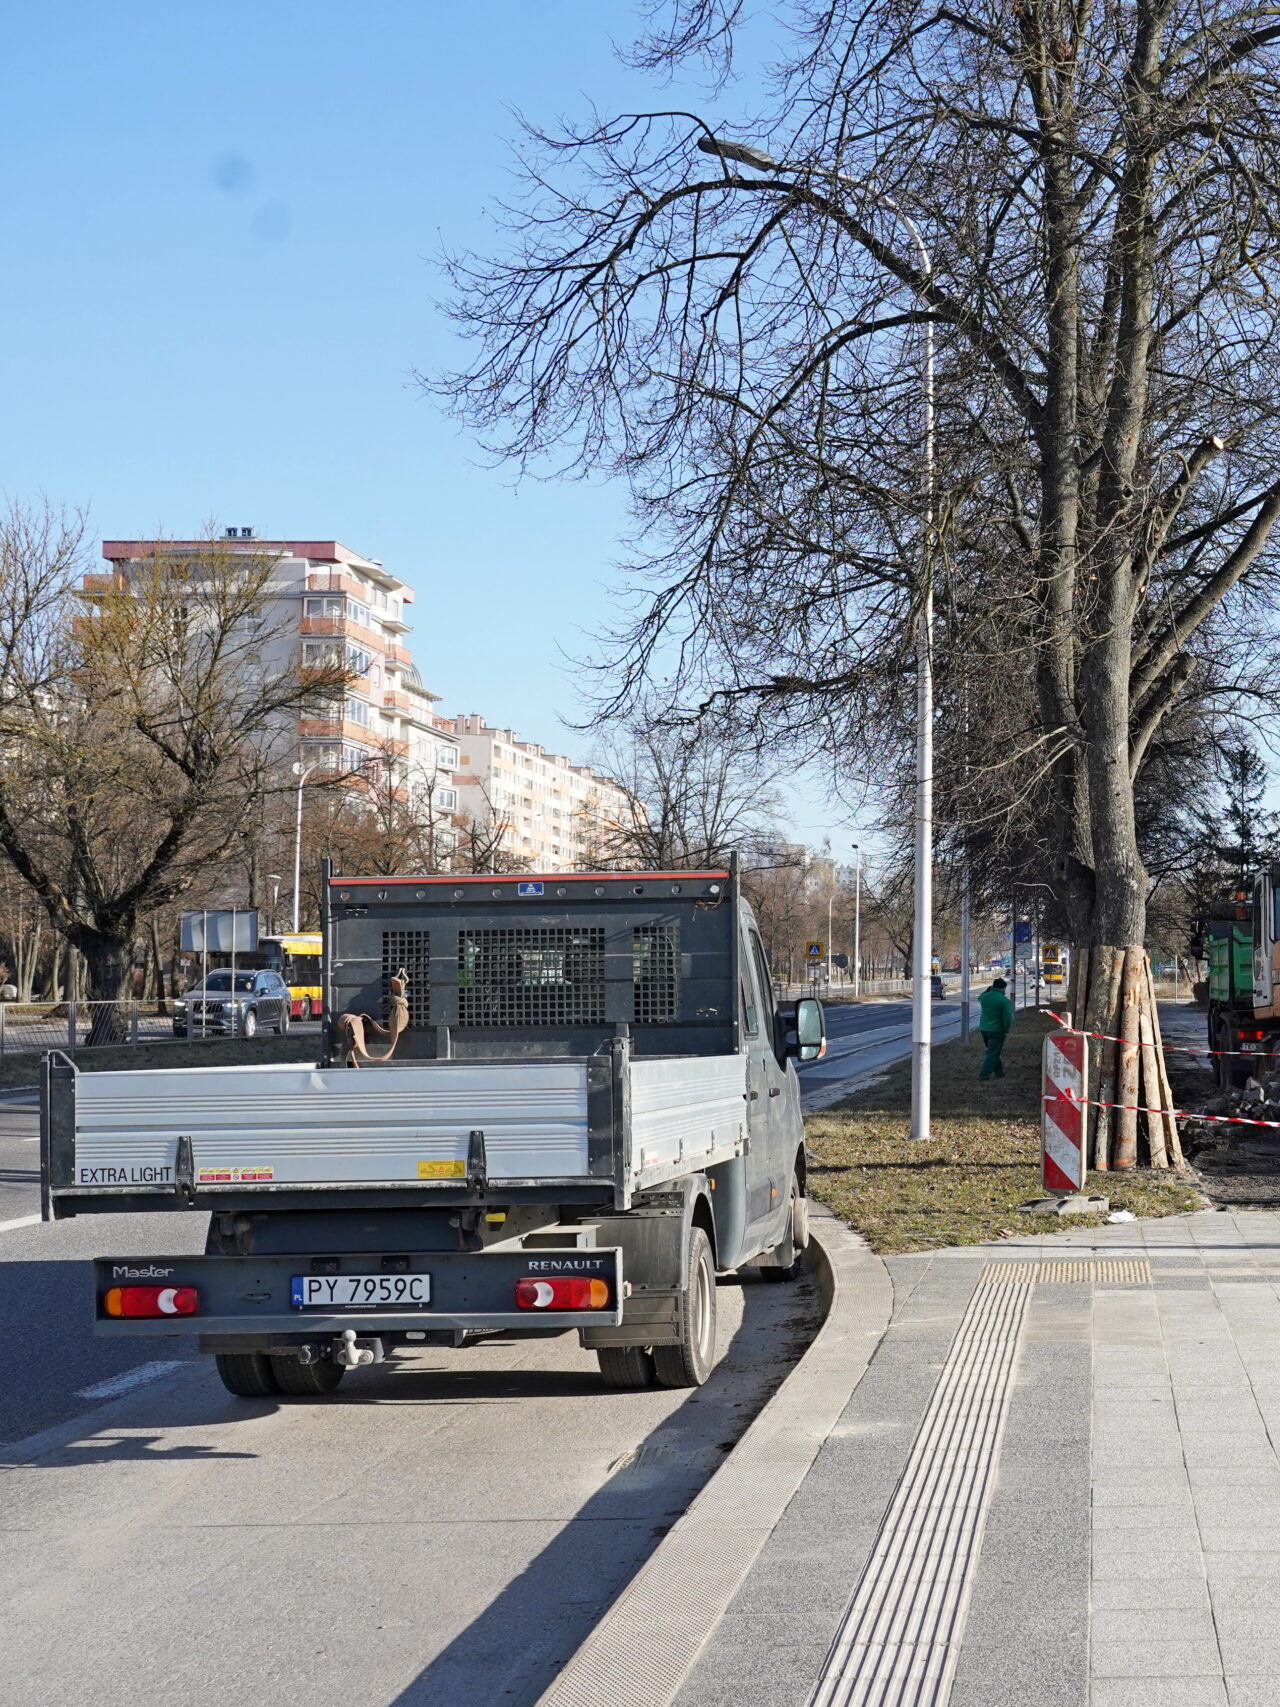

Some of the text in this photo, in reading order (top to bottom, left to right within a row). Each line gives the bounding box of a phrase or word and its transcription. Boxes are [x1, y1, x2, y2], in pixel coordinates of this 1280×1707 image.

[80, 1166, 172, 1183] EXTRA LIGHT
[112, 1264, 175, 1279] Master
[527, 1259, 604, 1271] RENAULT
[308, 1277, 423, 1303] PY 7959C
